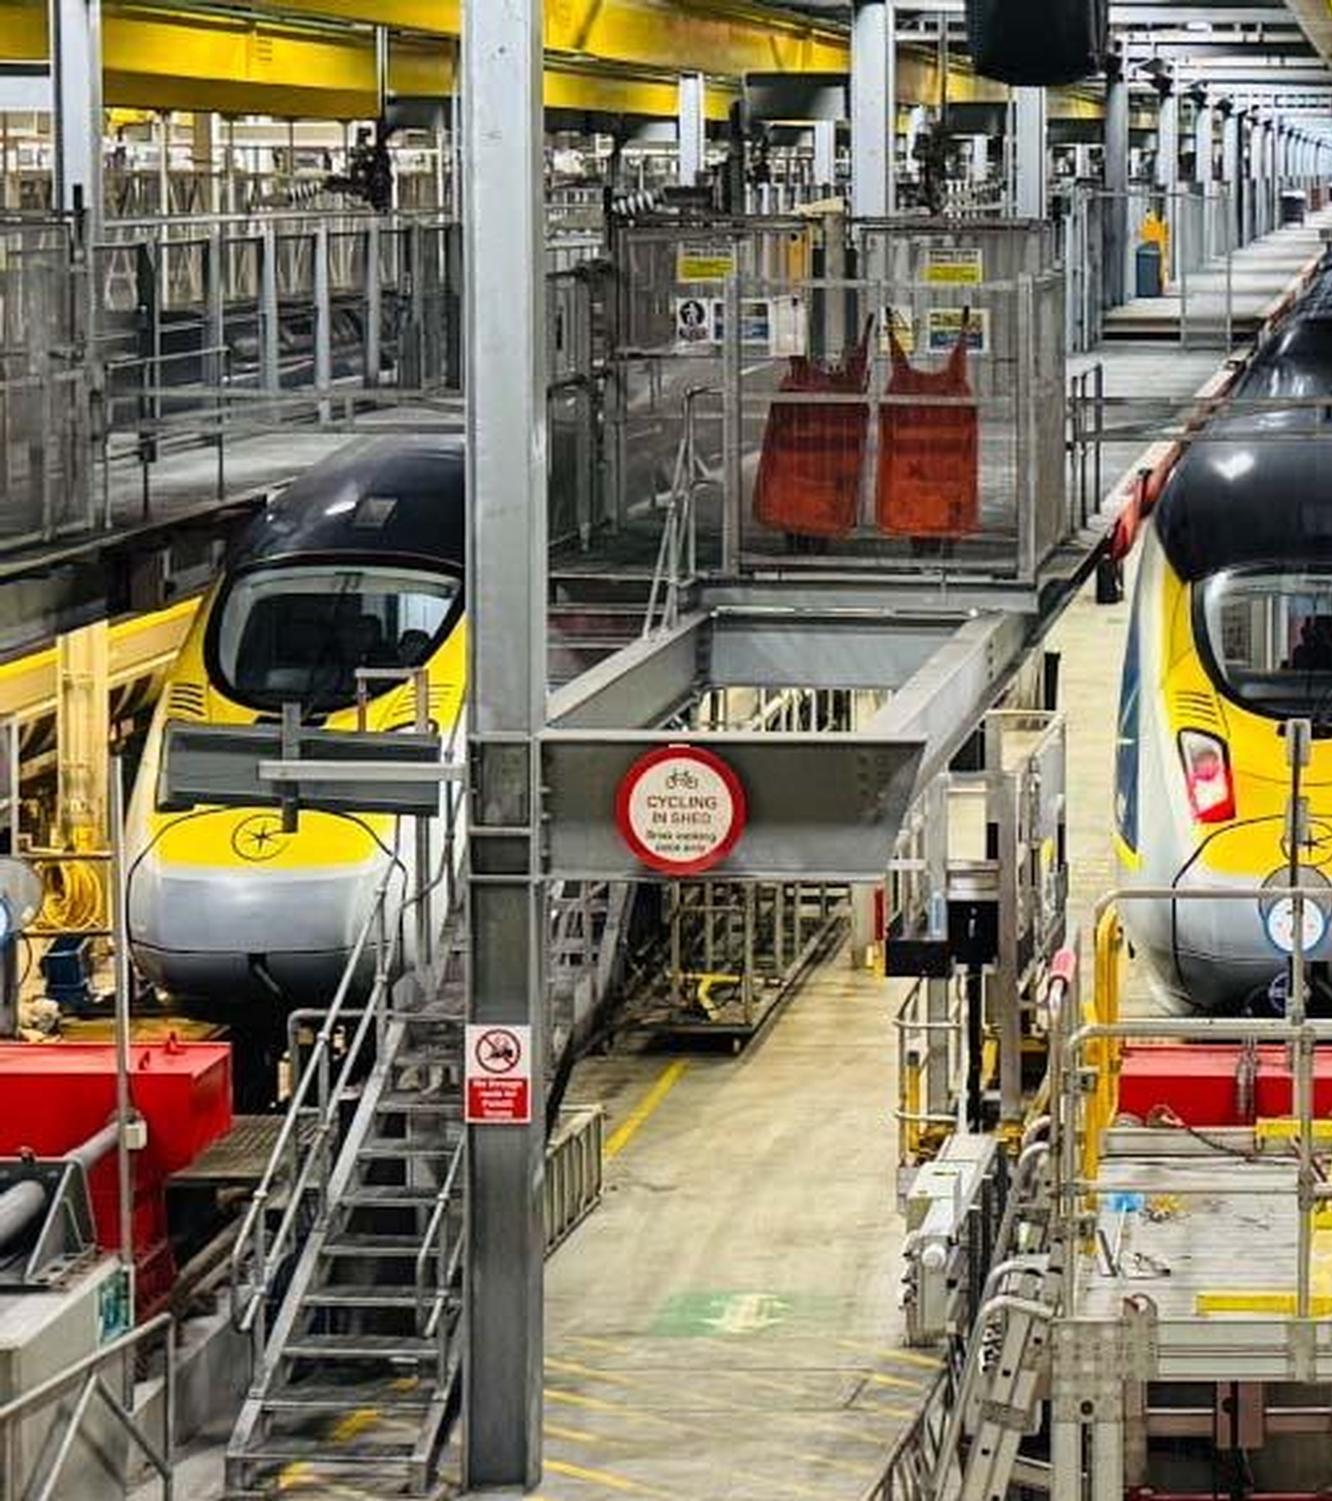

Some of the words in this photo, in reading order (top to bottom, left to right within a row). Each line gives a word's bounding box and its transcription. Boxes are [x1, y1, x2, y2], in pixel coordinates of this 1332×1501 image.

[647, 796, 717, 810] CYCLING
[652, 812, 667, 824] IN
[671, 812, 711, 824] SHED
